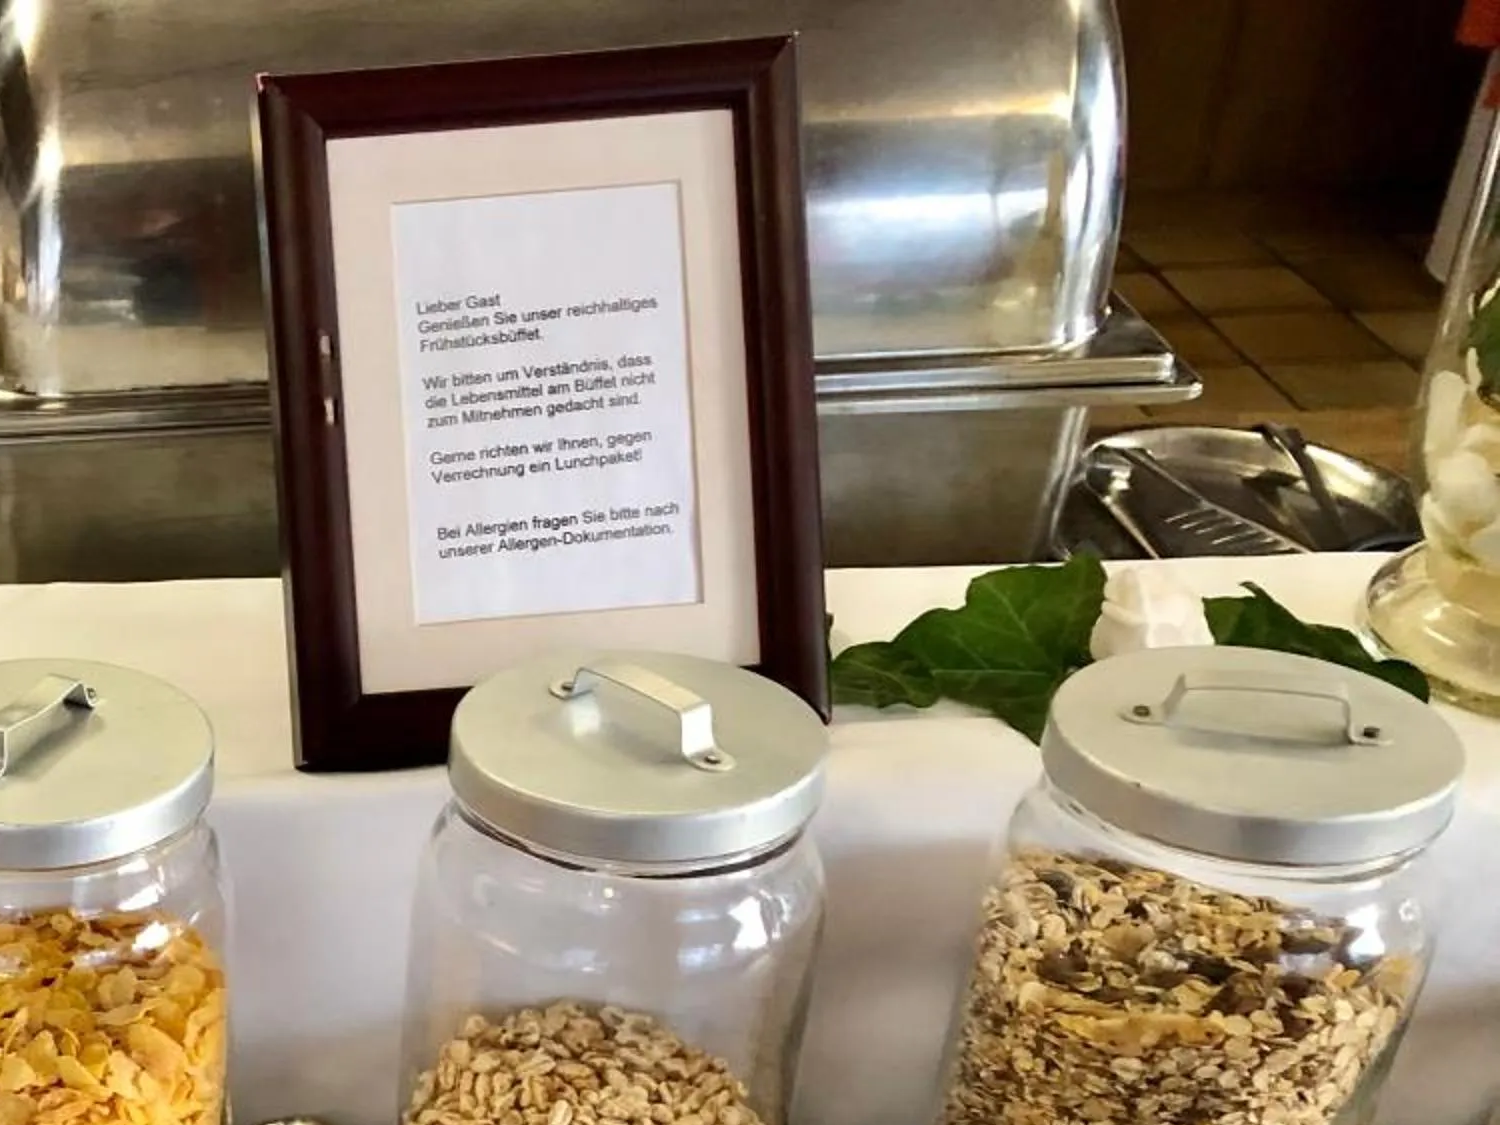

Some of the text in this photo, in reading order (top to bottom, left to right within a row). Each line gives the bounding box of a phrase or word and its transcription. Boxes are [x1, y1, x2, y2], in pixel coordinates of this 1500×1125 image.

[416, 294, 501, 315] Lieber Gast
[418, 297, 658, 334] Genießen Sie unser reichhaltiges
[422, 376, 447, 390] Wir
[452, 372, 492, 387] bitten
[496, 369, 519, 383] um
[617, 355, 651, 368] dass
[425, 372, 656, 409] die Lebensmittel am Büffet nicht
[427, 415, 458, 429] zum
[462, 405, 542, 425] Mitnehmen
[546, 397, 604, 417] gedacht
[430, 430, 652, 465] Gerne richten wir Ihnen, gegen
[431, 462, 525, 484] Verrechnung
[529, 458, 550, 472] ein
[437, 502, 679, 540] Bei Allergien fragen Sie bitte nach
[439, 542, 497, 559] unserer
